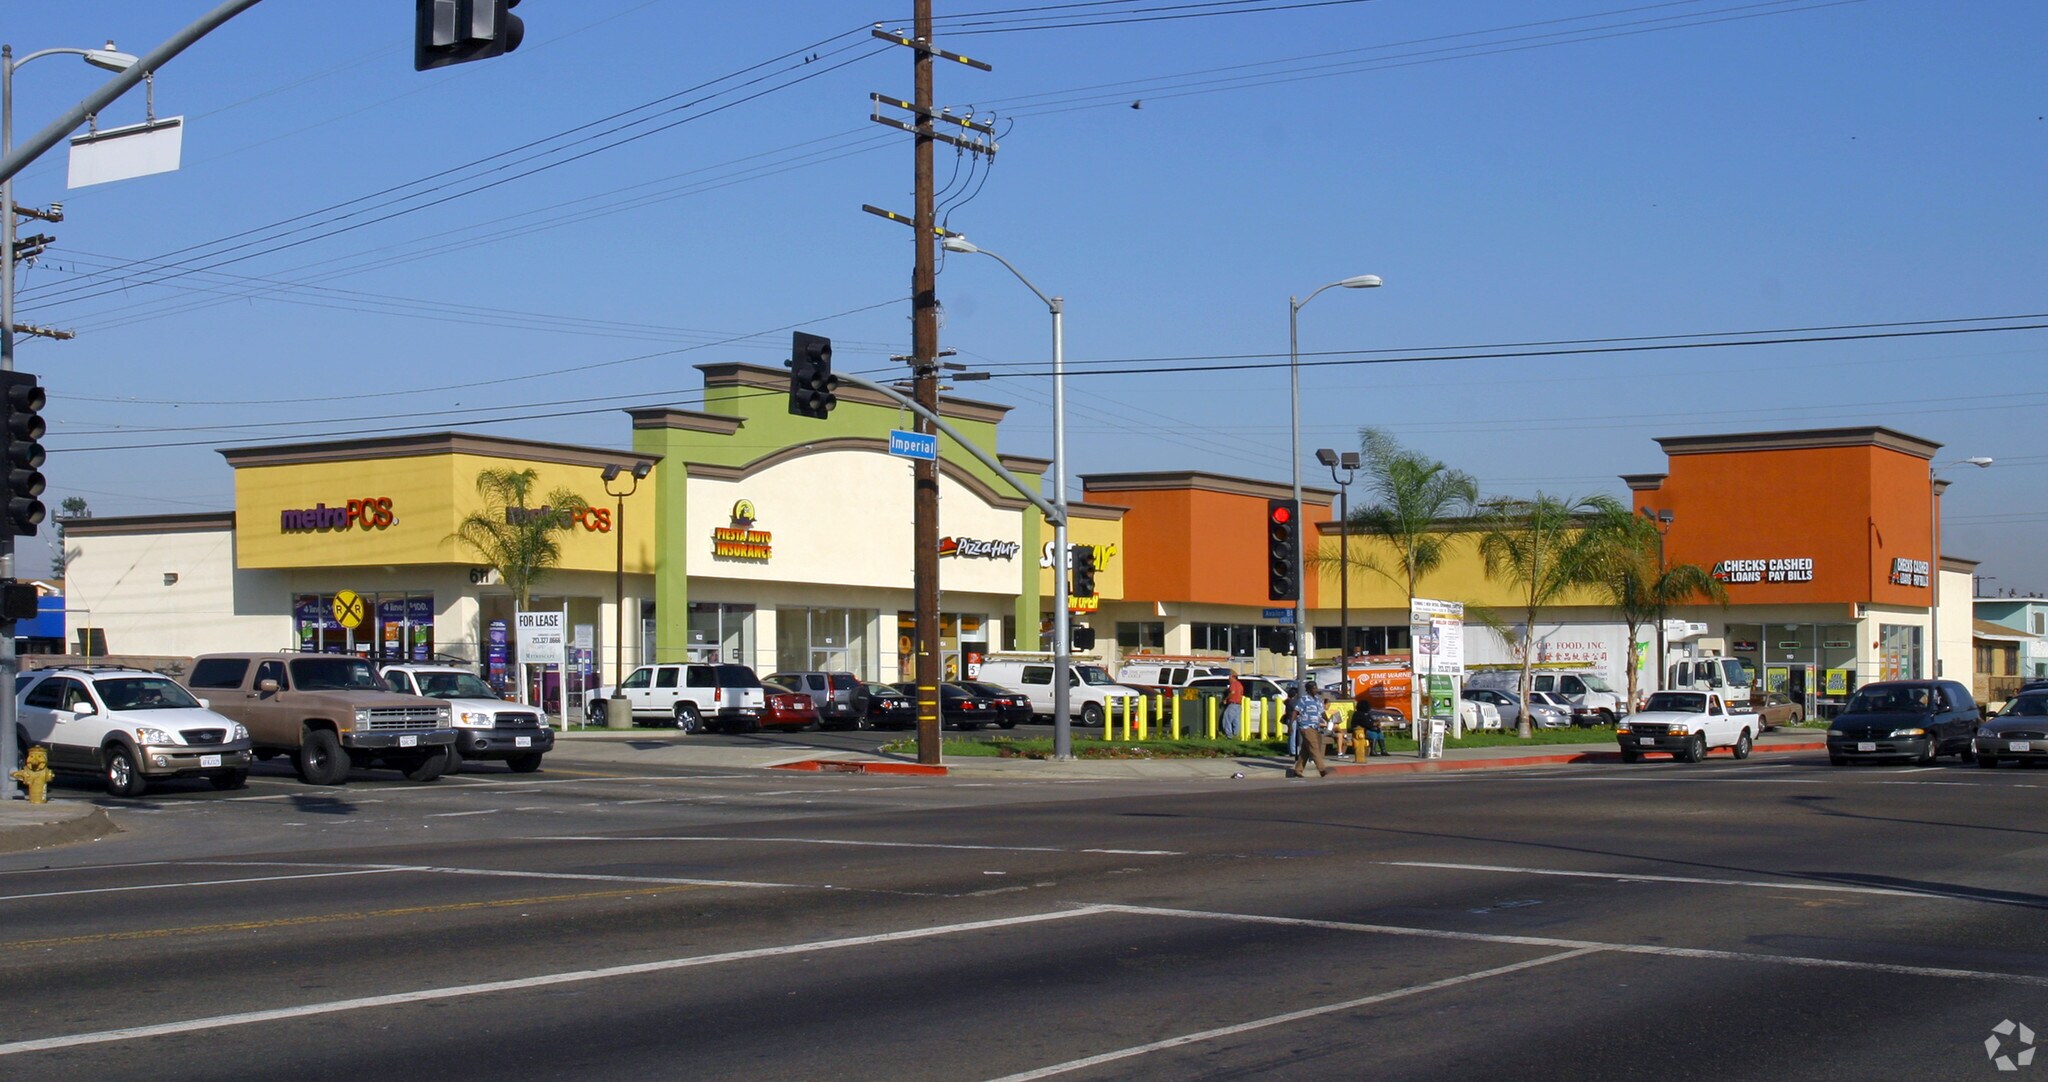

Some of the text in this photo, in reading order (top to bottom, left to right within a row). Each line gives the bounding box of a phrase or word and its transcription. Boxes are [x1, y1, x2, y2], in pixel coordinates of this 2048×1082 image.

[892, 436, 934, 454] Imperial
[281, 497, 393, 531] metroPCS
[715, 527, 772, 543] FIESTA AUTO
[715, 542, 772, 558] INSURANCE
[1724, 558, 1812, 572] CHECKS CASHED
[470, 568, 489, 584] 611
[1732, 570, 1812, 582] LOANS PAY BILLS
[336, 604, 362, 614] R R
[520, 614, 534, 627] FOR
[536, 614, 558, 626] LEASE
[1588, 642, 1607, 650] INC.
